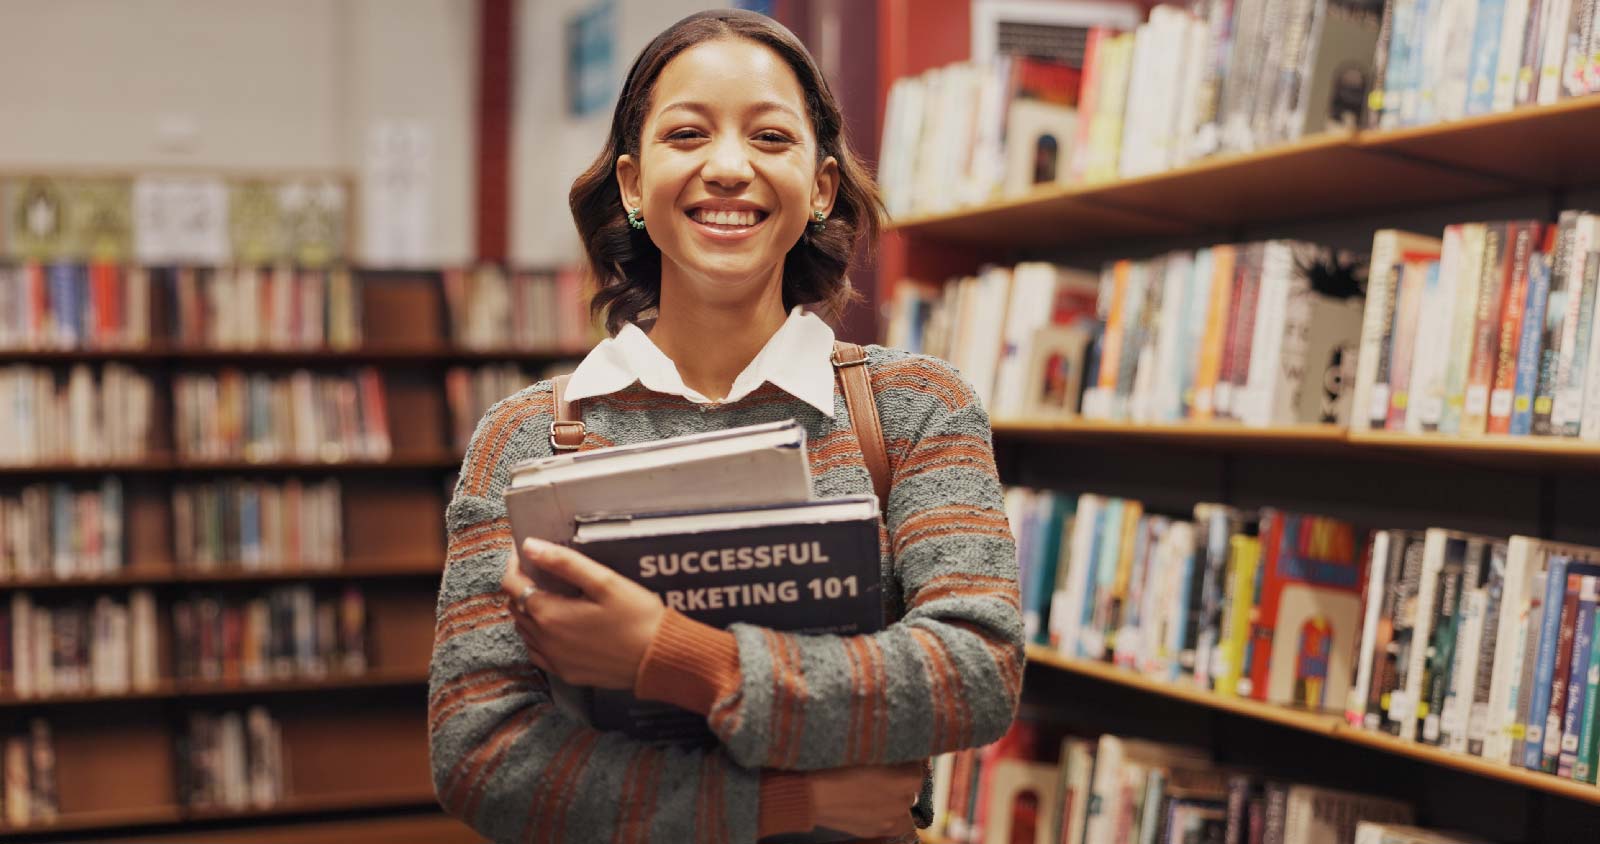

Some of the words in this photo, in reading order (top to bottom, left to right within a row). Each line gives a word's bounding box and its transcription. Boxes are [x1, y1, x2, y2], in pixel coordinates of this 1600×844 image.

[639, 541, 829, 578] SUCCESSFUL
[657, 581, 799, 611] RKETING
[807, 575, 858, 600] 101
